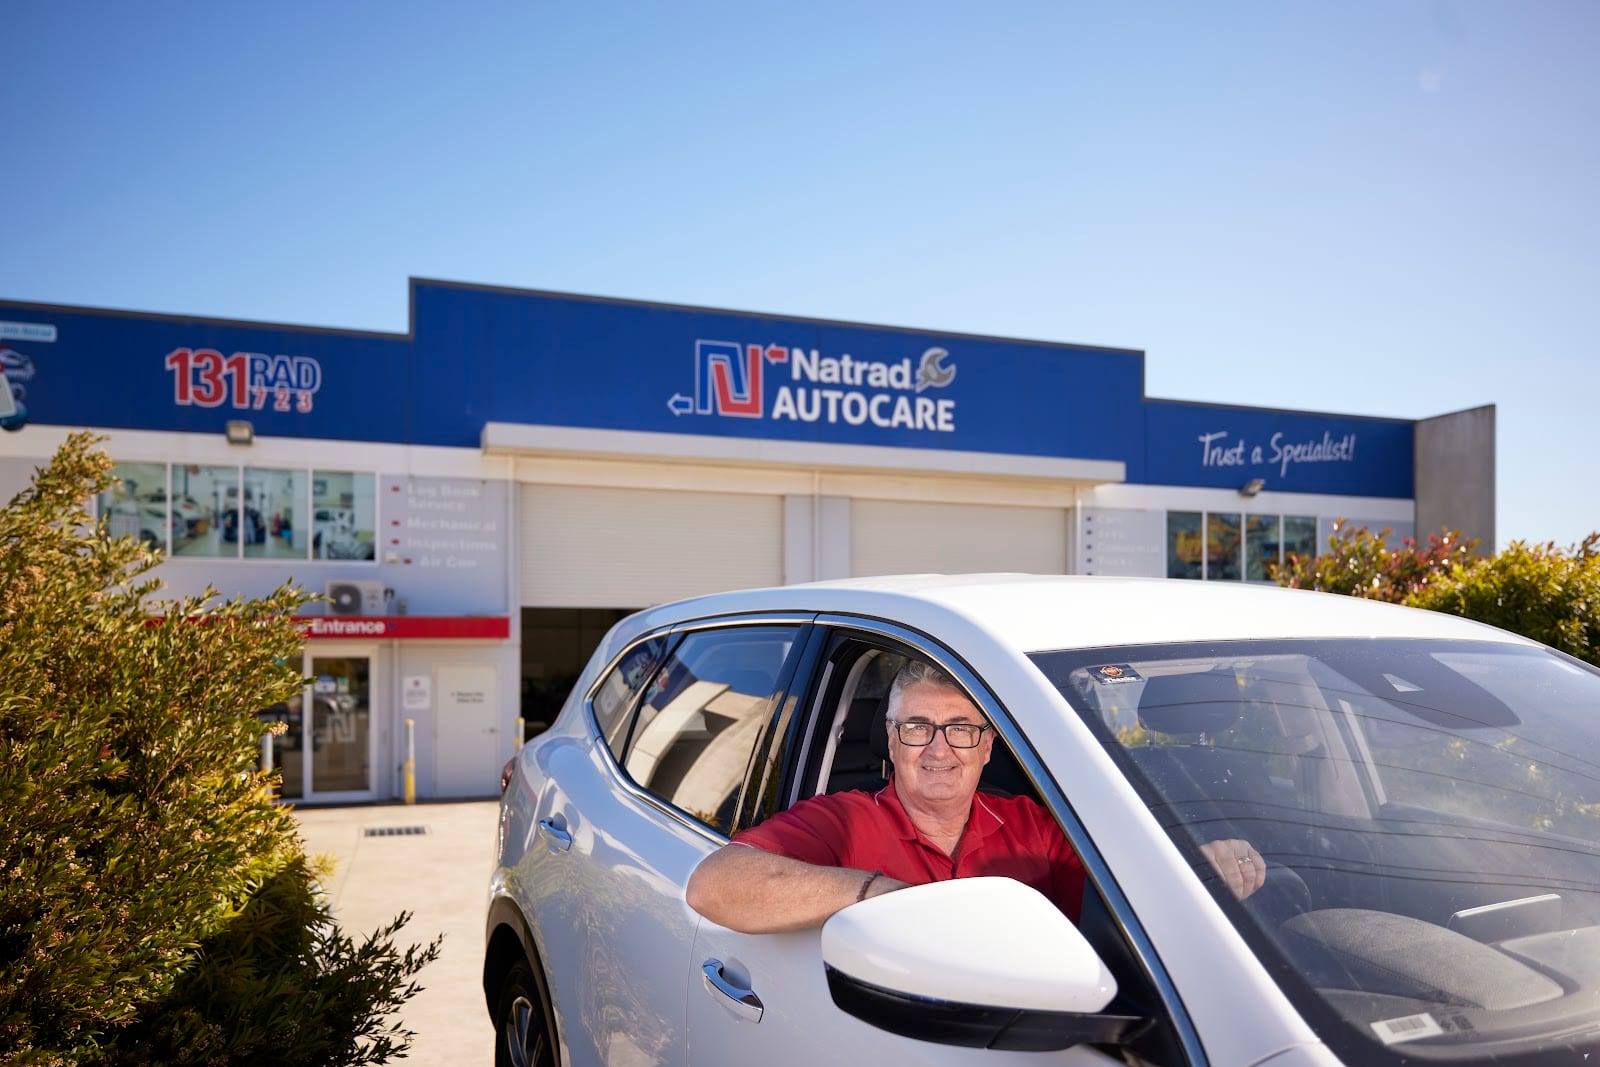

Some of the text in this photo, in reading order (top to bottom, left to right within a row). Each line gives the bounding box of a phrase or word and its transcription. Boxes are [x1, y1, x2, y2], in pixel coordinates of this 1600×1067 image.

[164, 348, 322, 408] 131 RAD
[791, 348, 911, 389] Natrad
[772, 386, 956, 432] AUTOCARE
[1198, 431, 1356, 478] Trust a Specialist!
[407, 516, 496, 531] Mechanical
[407, 537, 497, 551] Inspections
[312, 618, 386, 634] Entrance
